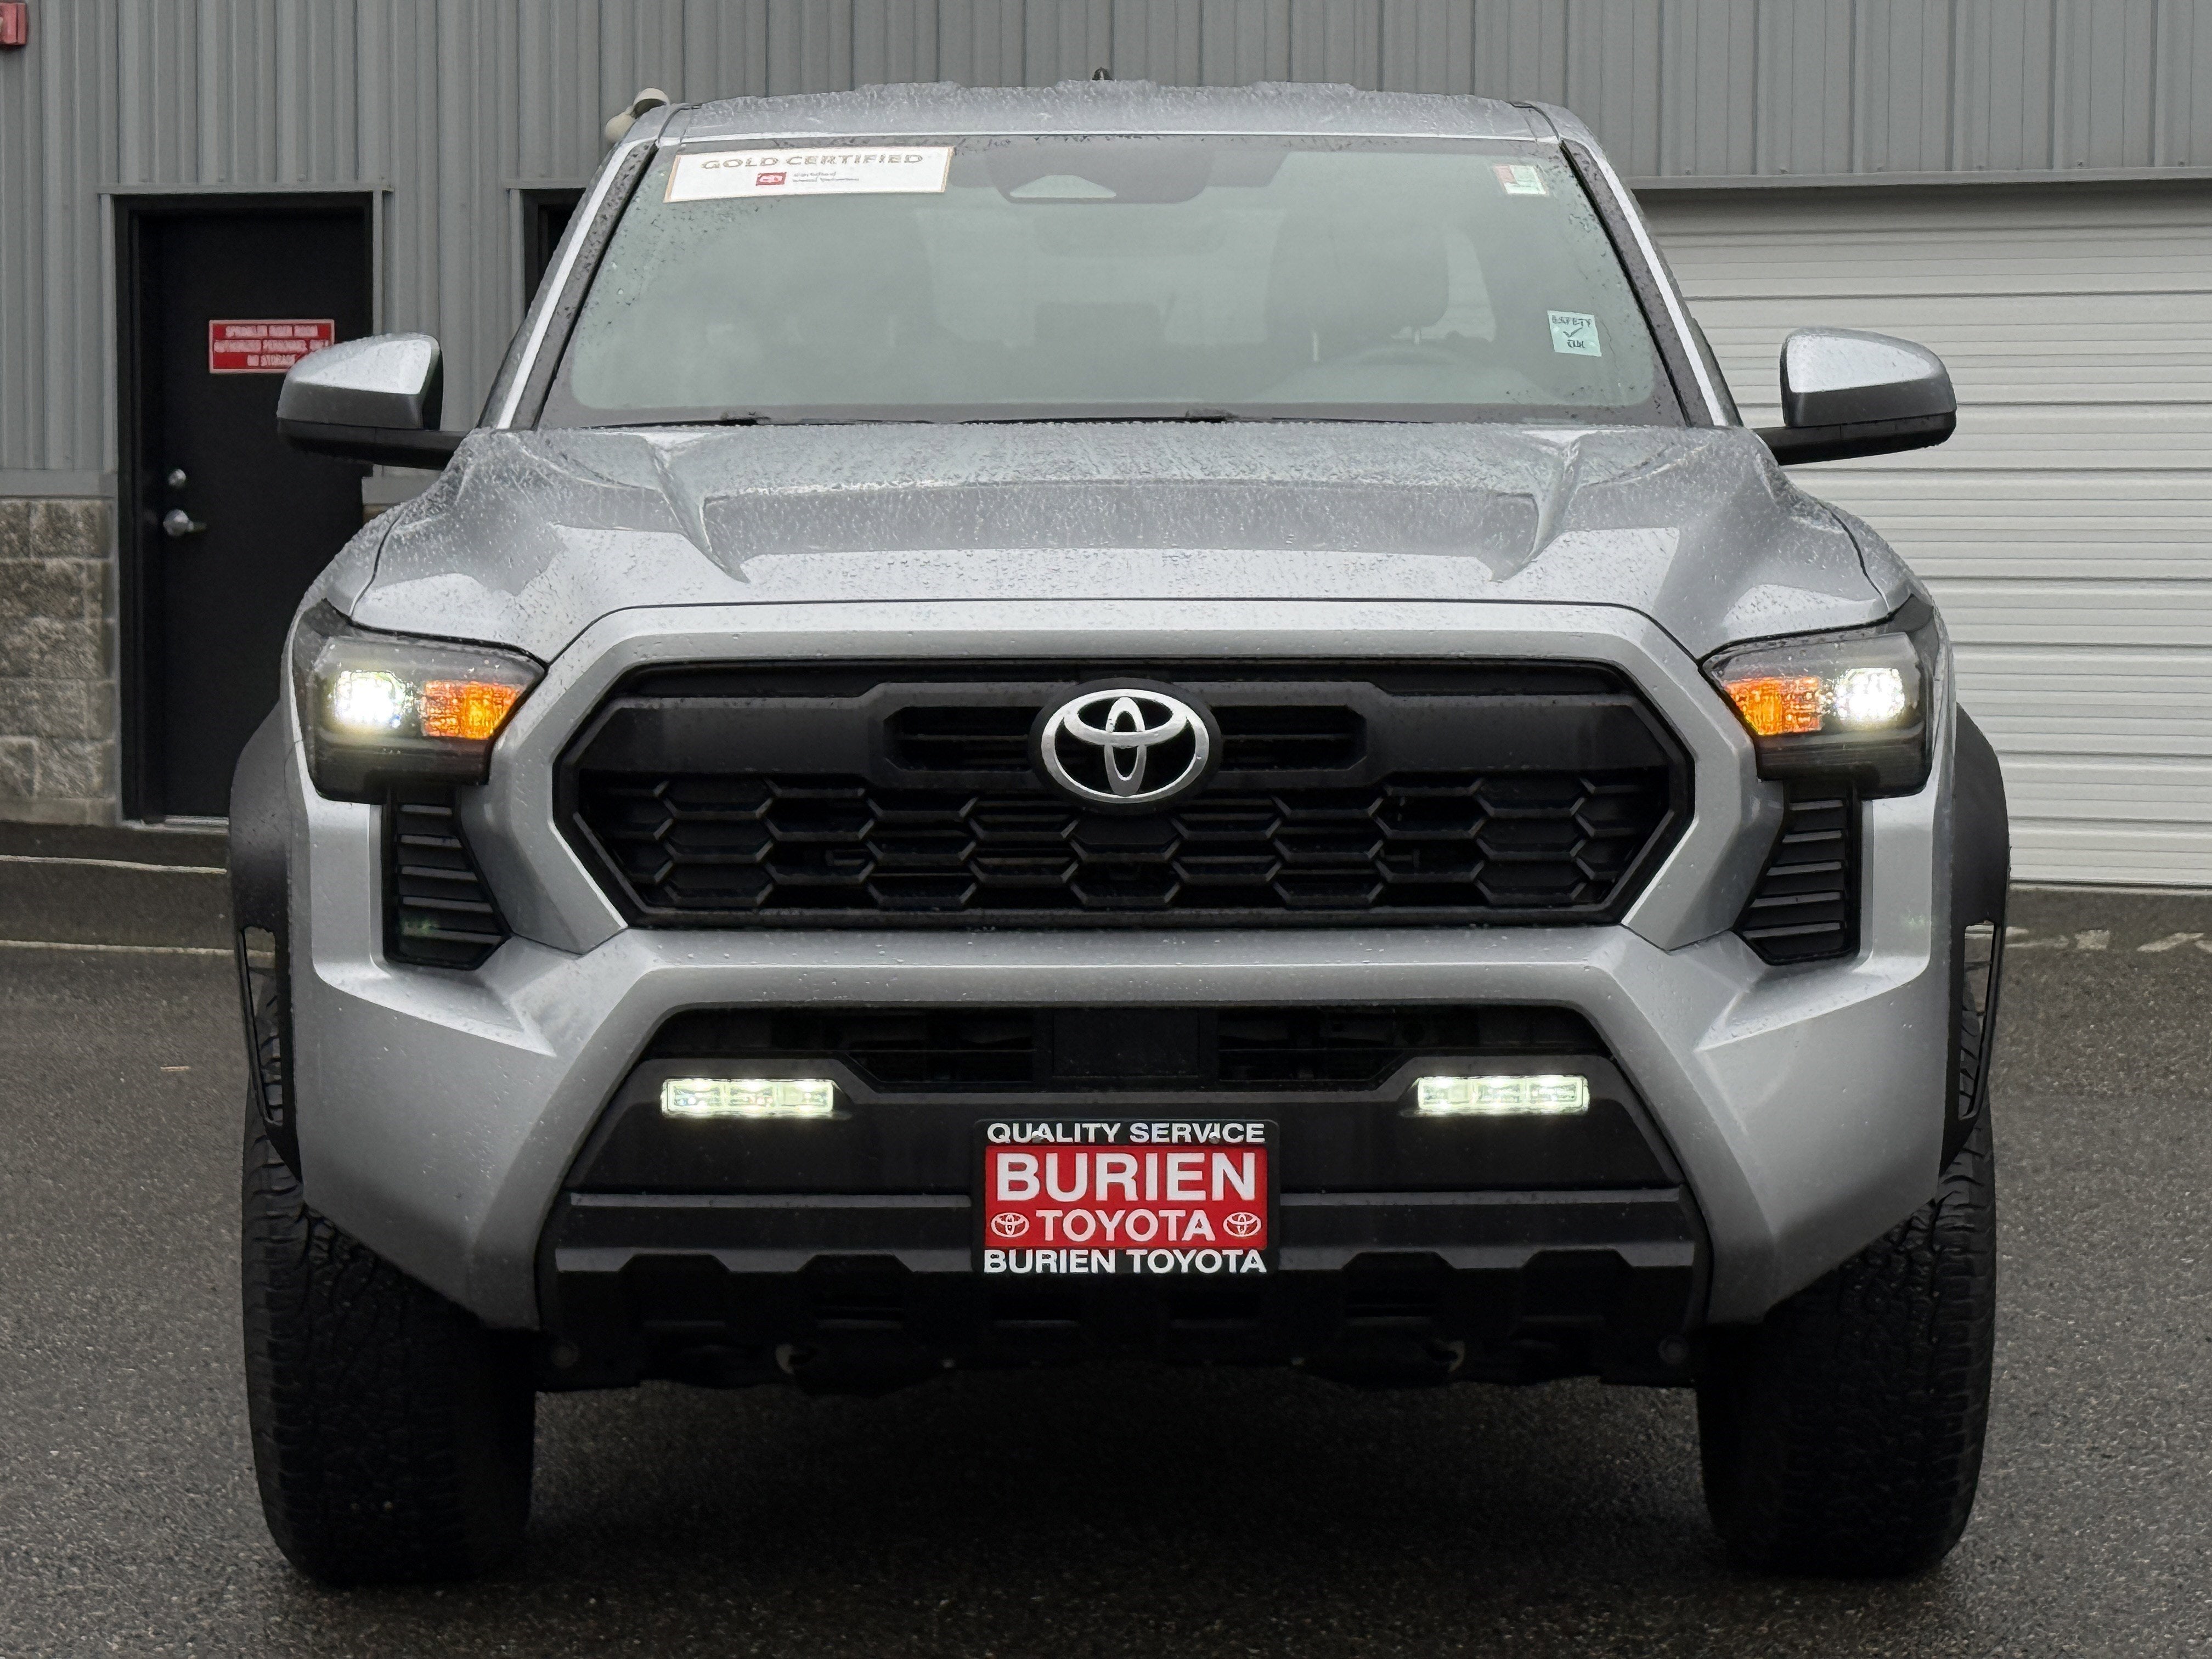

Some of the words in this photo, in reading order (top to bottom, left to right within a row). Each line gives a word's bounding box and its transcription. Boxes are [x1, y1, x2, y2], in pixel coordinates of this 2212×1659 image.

[702, 157, 779, 170] GOLD
[786, 154, 923, 165] CERTIFIED
[987, 1122, 1121, 1143] QUALITY
[1130, 1123, 1265, 1143] SERVICE
[997, 1152, 1255, 1201] BURIEN
[1036, 1209, 1216, 1242] TOYOTA
[984, 1249, 1116, 1273] BURIEN
[1126, 1249, 1267, 1273] TOYOTA
